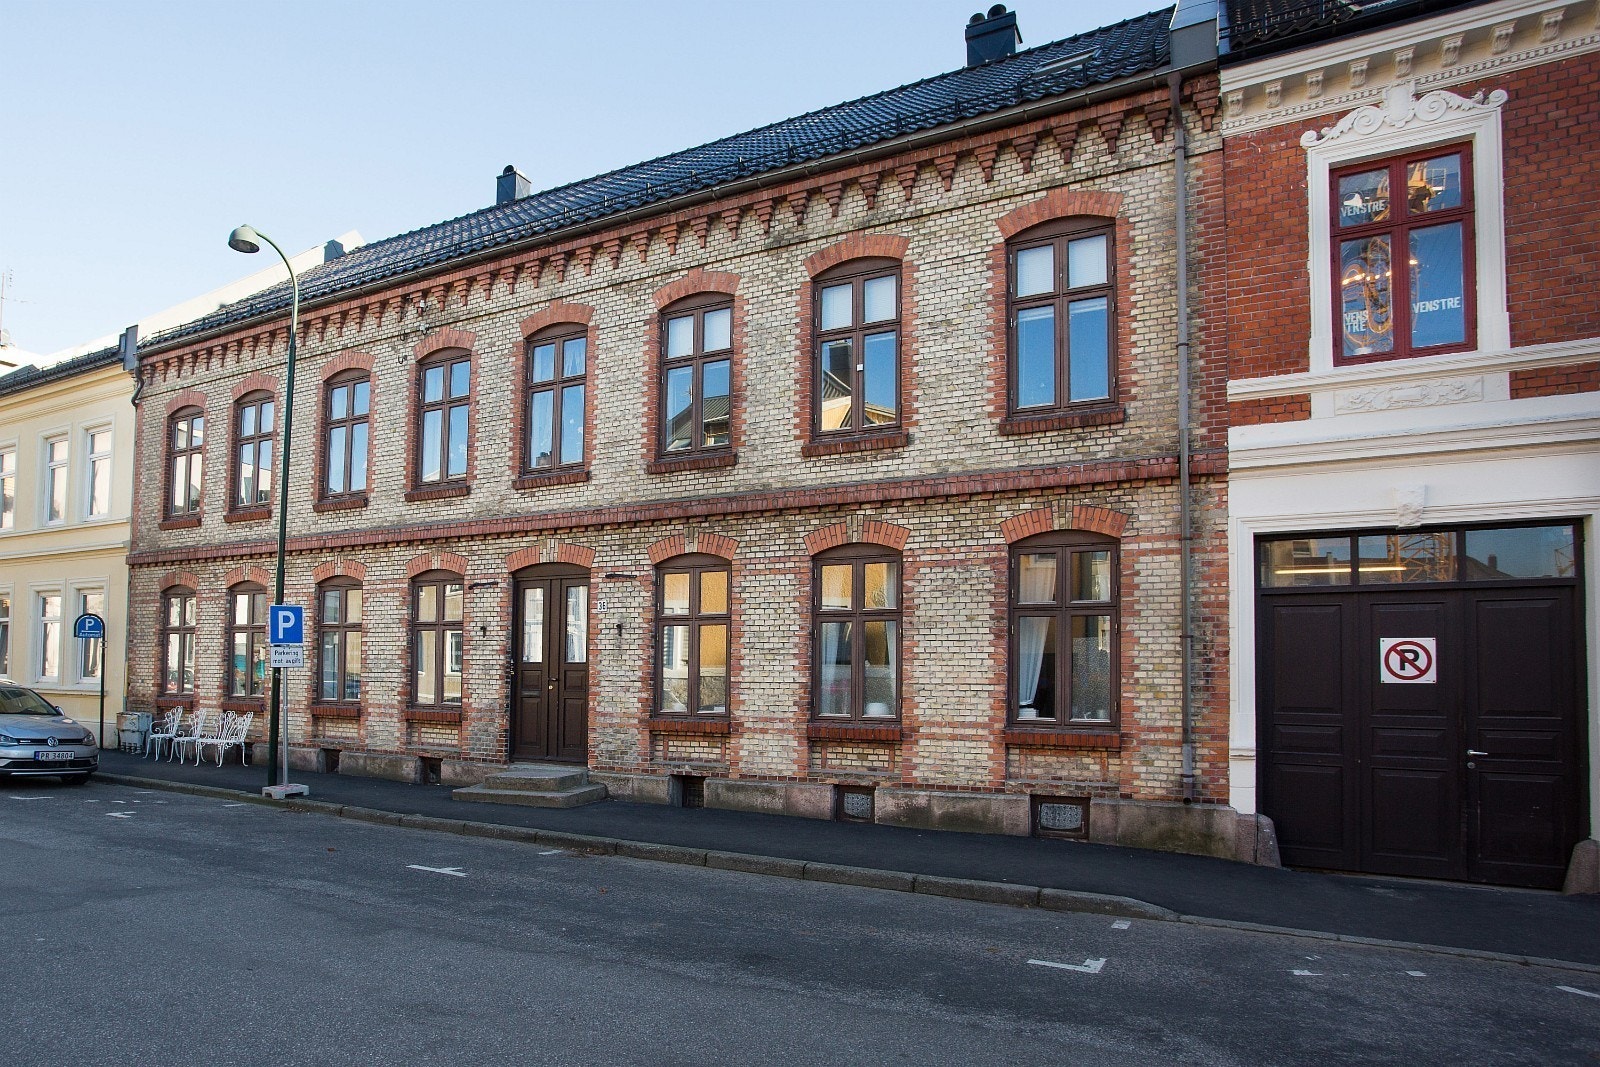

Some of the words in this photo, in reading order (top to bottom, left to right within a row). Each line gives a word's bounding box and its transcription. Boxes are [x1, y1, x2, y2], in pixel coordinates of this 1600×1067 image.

[1341, 200, 1387, 217] VENSTRE
[1412, 297, 1461, 314] VENSTRE
[85, 618, 95, 631] P
[278, 610, 296, 639] P
[1399, 648, 1420, 671] P
[40, 752, 51, 760] PR
[52, 752, 73, 760] 34804
